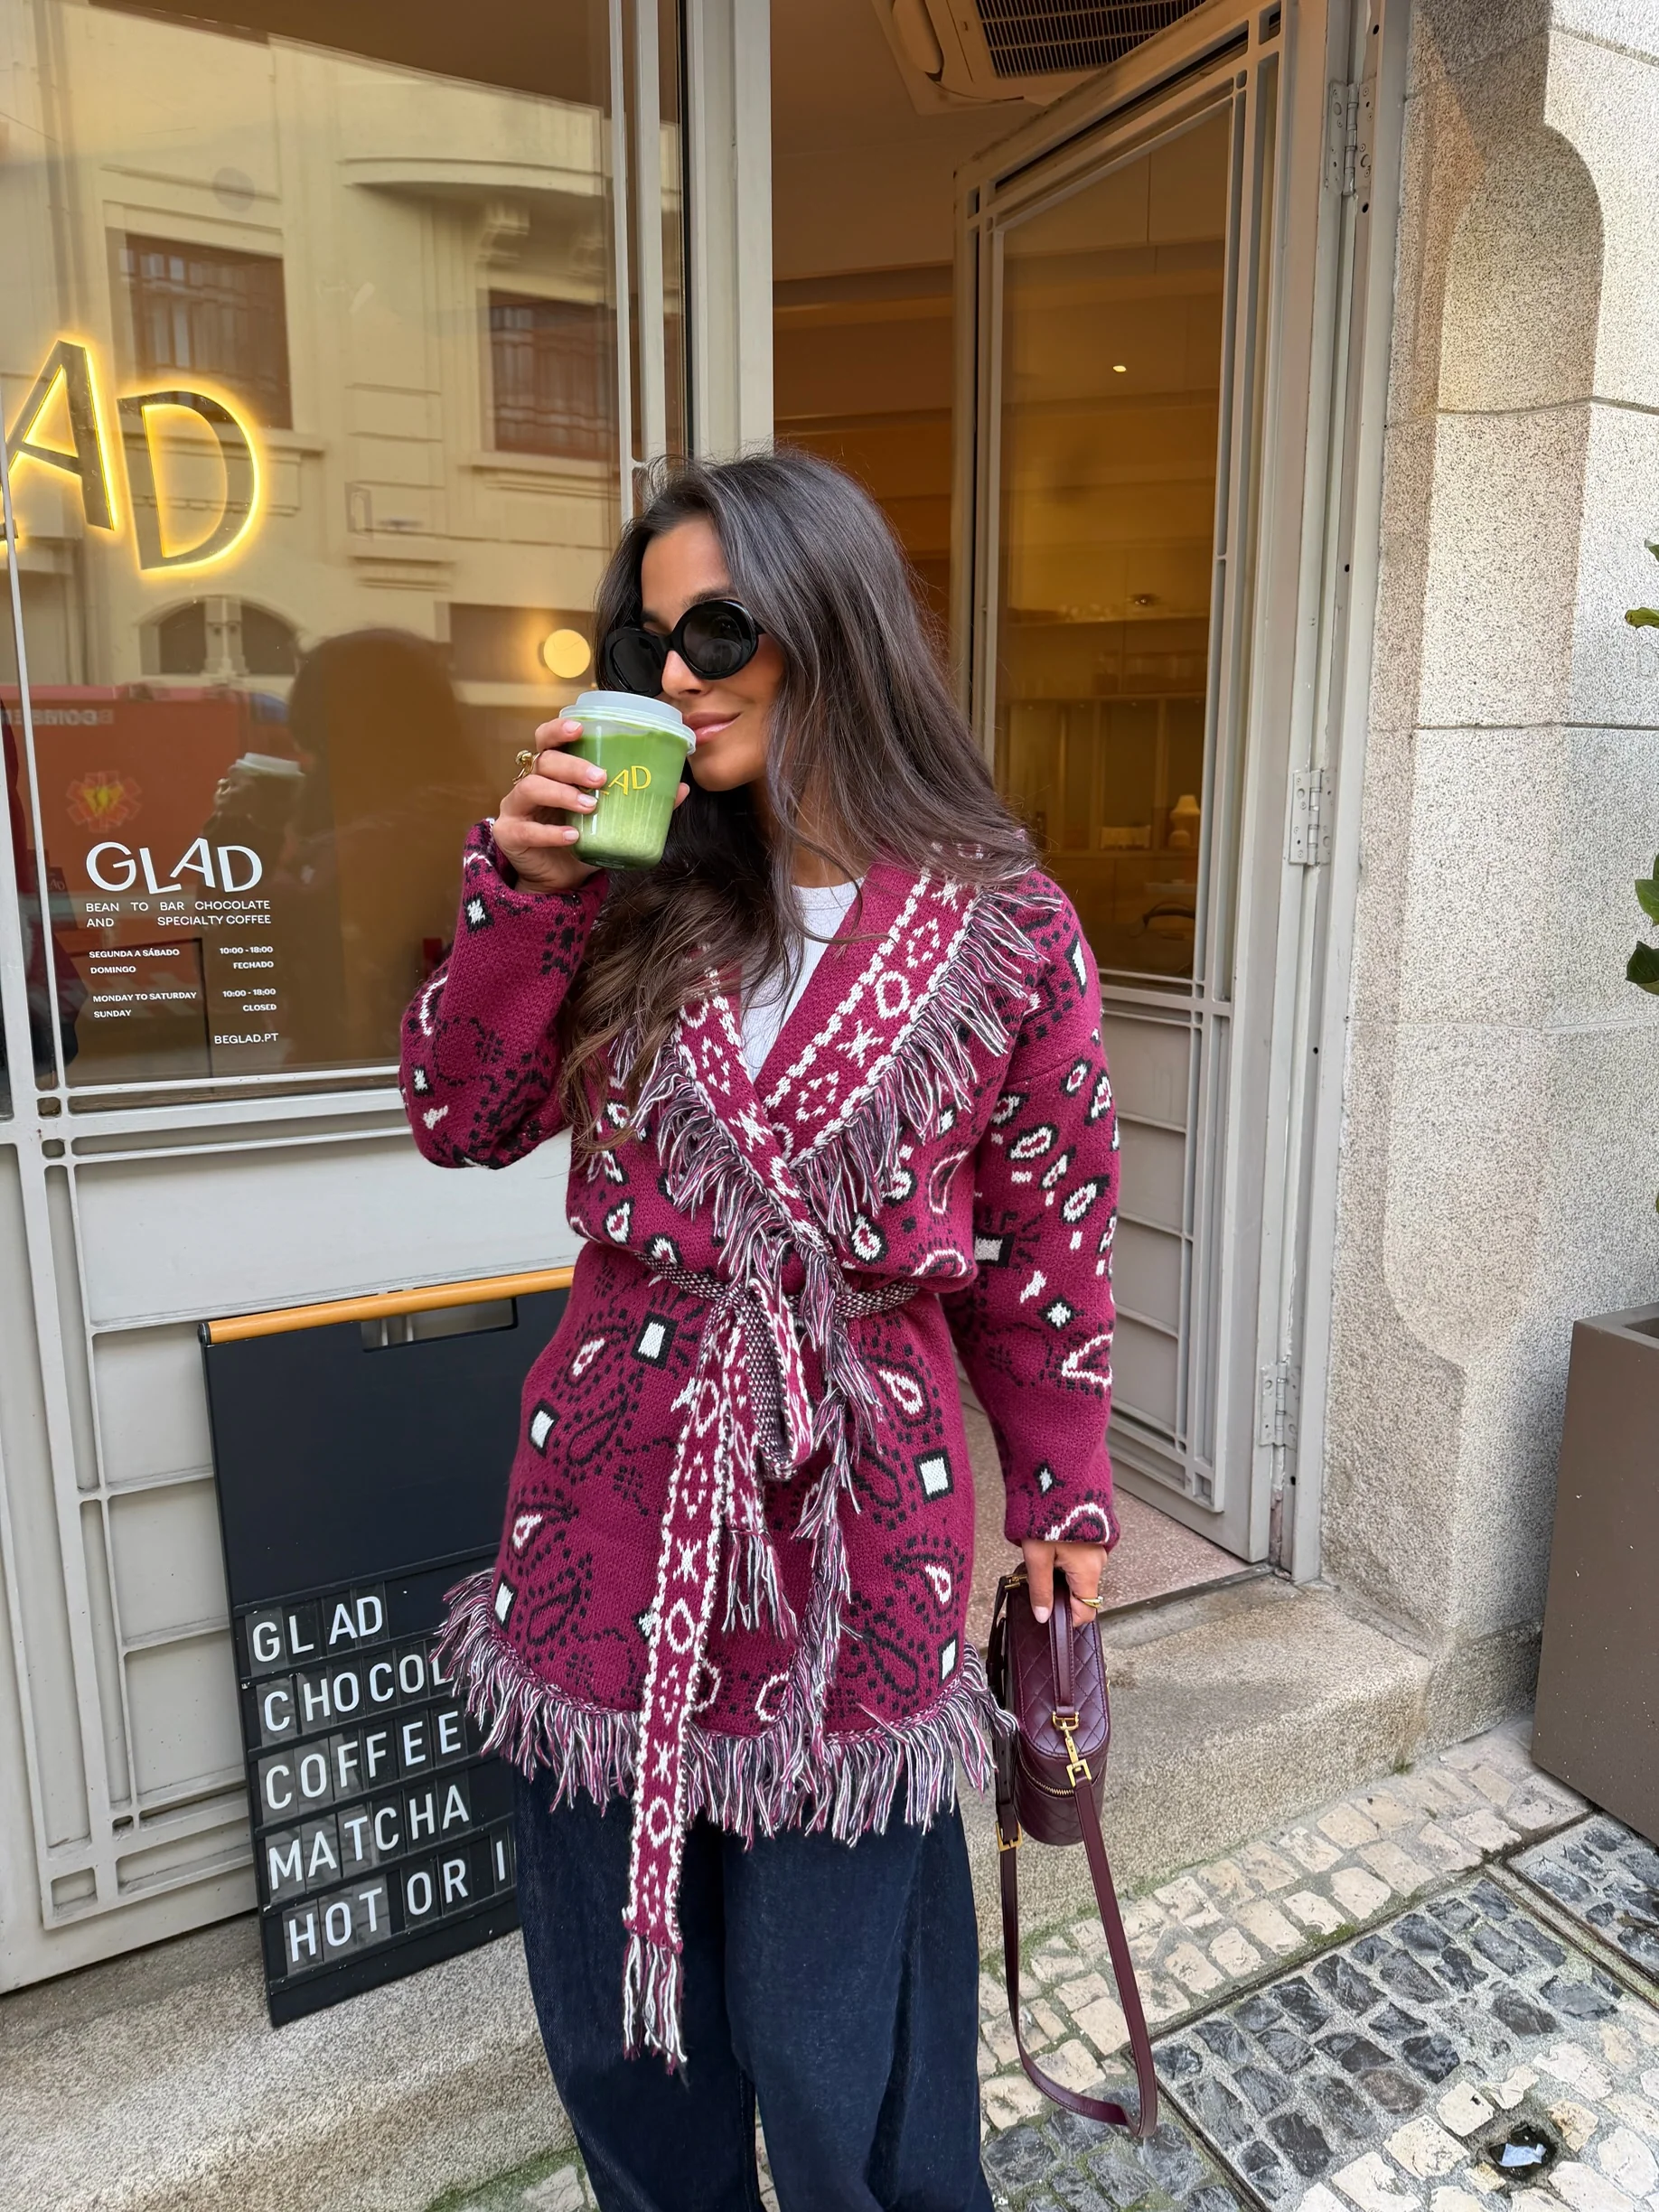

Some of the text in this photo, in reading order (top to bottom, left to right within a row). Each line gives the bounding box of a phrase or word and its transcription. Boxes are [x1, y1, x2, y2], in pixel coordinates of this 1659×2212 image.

[0, 340, 255, 570] AD
[600, 765, 651, 796] AD
[86, 837, 263, 895] GLAD
[86, 900, 270, 912] BEAN TO BAR CHOCOLATE
[87, 914, 271, 927] AND SPECIALTY COFFEE
[89, 950, 132, 958] SEGUNDA
[142, 948, 180, 957] SÁBADO
[249, 945, 274, 953] 18:00
[90, 961, 274, 974] DOMINGO FECHADO
[93, 994, 134, 1002] MONDAY
[149, 992, 197, 1000] SATURDAY
[222, 989, 247, 998] 10:00
[93, 1003, 277, 1018] SUNDAY CLOSED
[214, 1033, 278, 1045] BEGLAD.PT
[252, 1596, 383, 1662] GLAD
[264, 1650, 455, 1731] CHOCOL
[266, 1711, 462, 1808] COFFEE
[268, 1784, 470, 1890] MATCHA
[288, 1887, 382, 1963] HOT
[407, 1858, 468, 1916] OR
